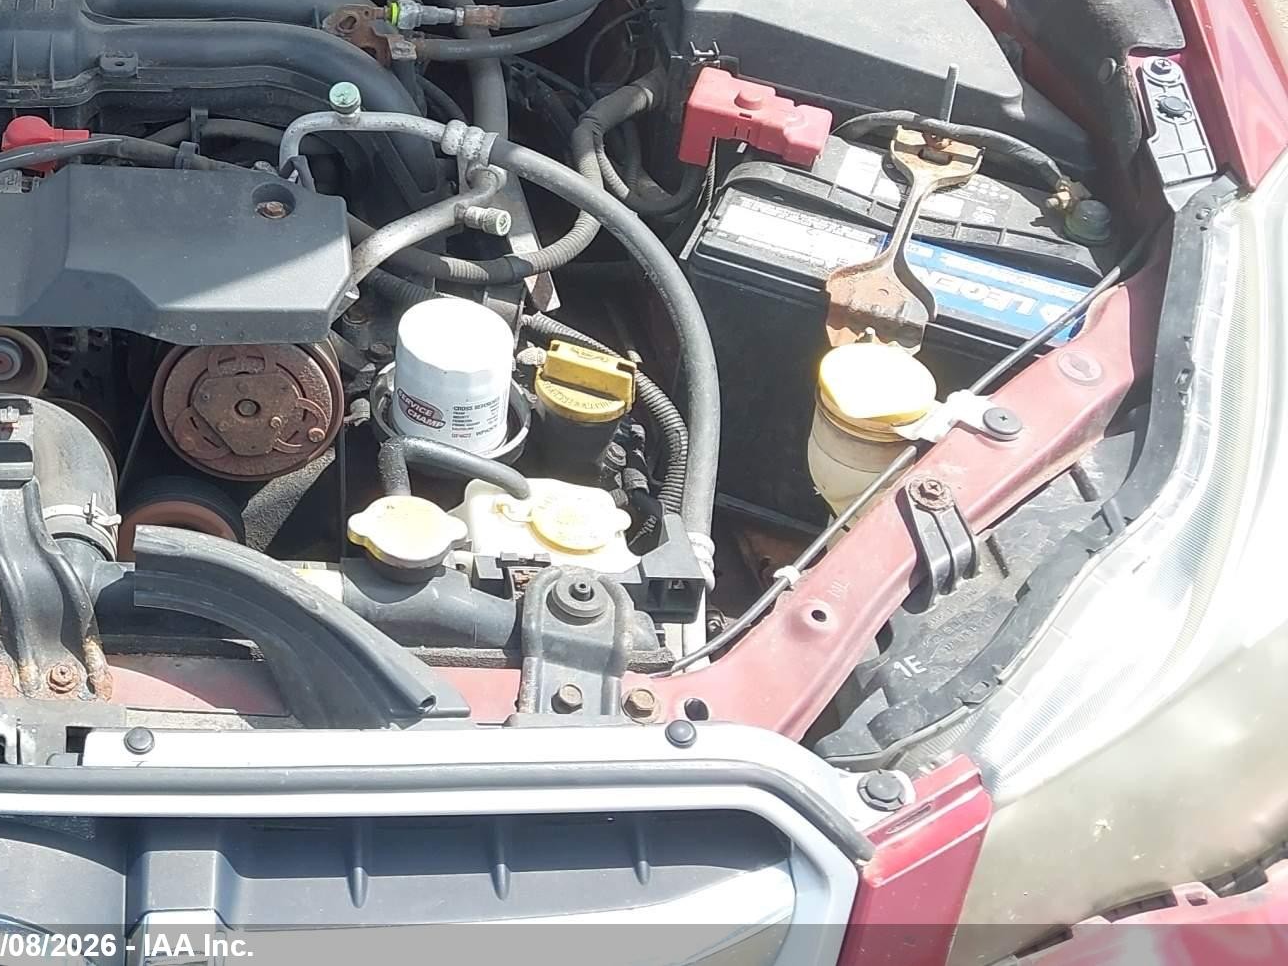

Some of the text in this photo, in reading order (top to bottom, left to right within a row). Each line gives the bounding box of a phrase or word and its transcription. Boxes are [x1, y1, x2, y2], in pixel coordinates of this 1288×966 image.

[398, 390, 434, 417] SERVICE
[407, 409, 445, 428] CHAMP
[894, 654, 927, 678] 1E
